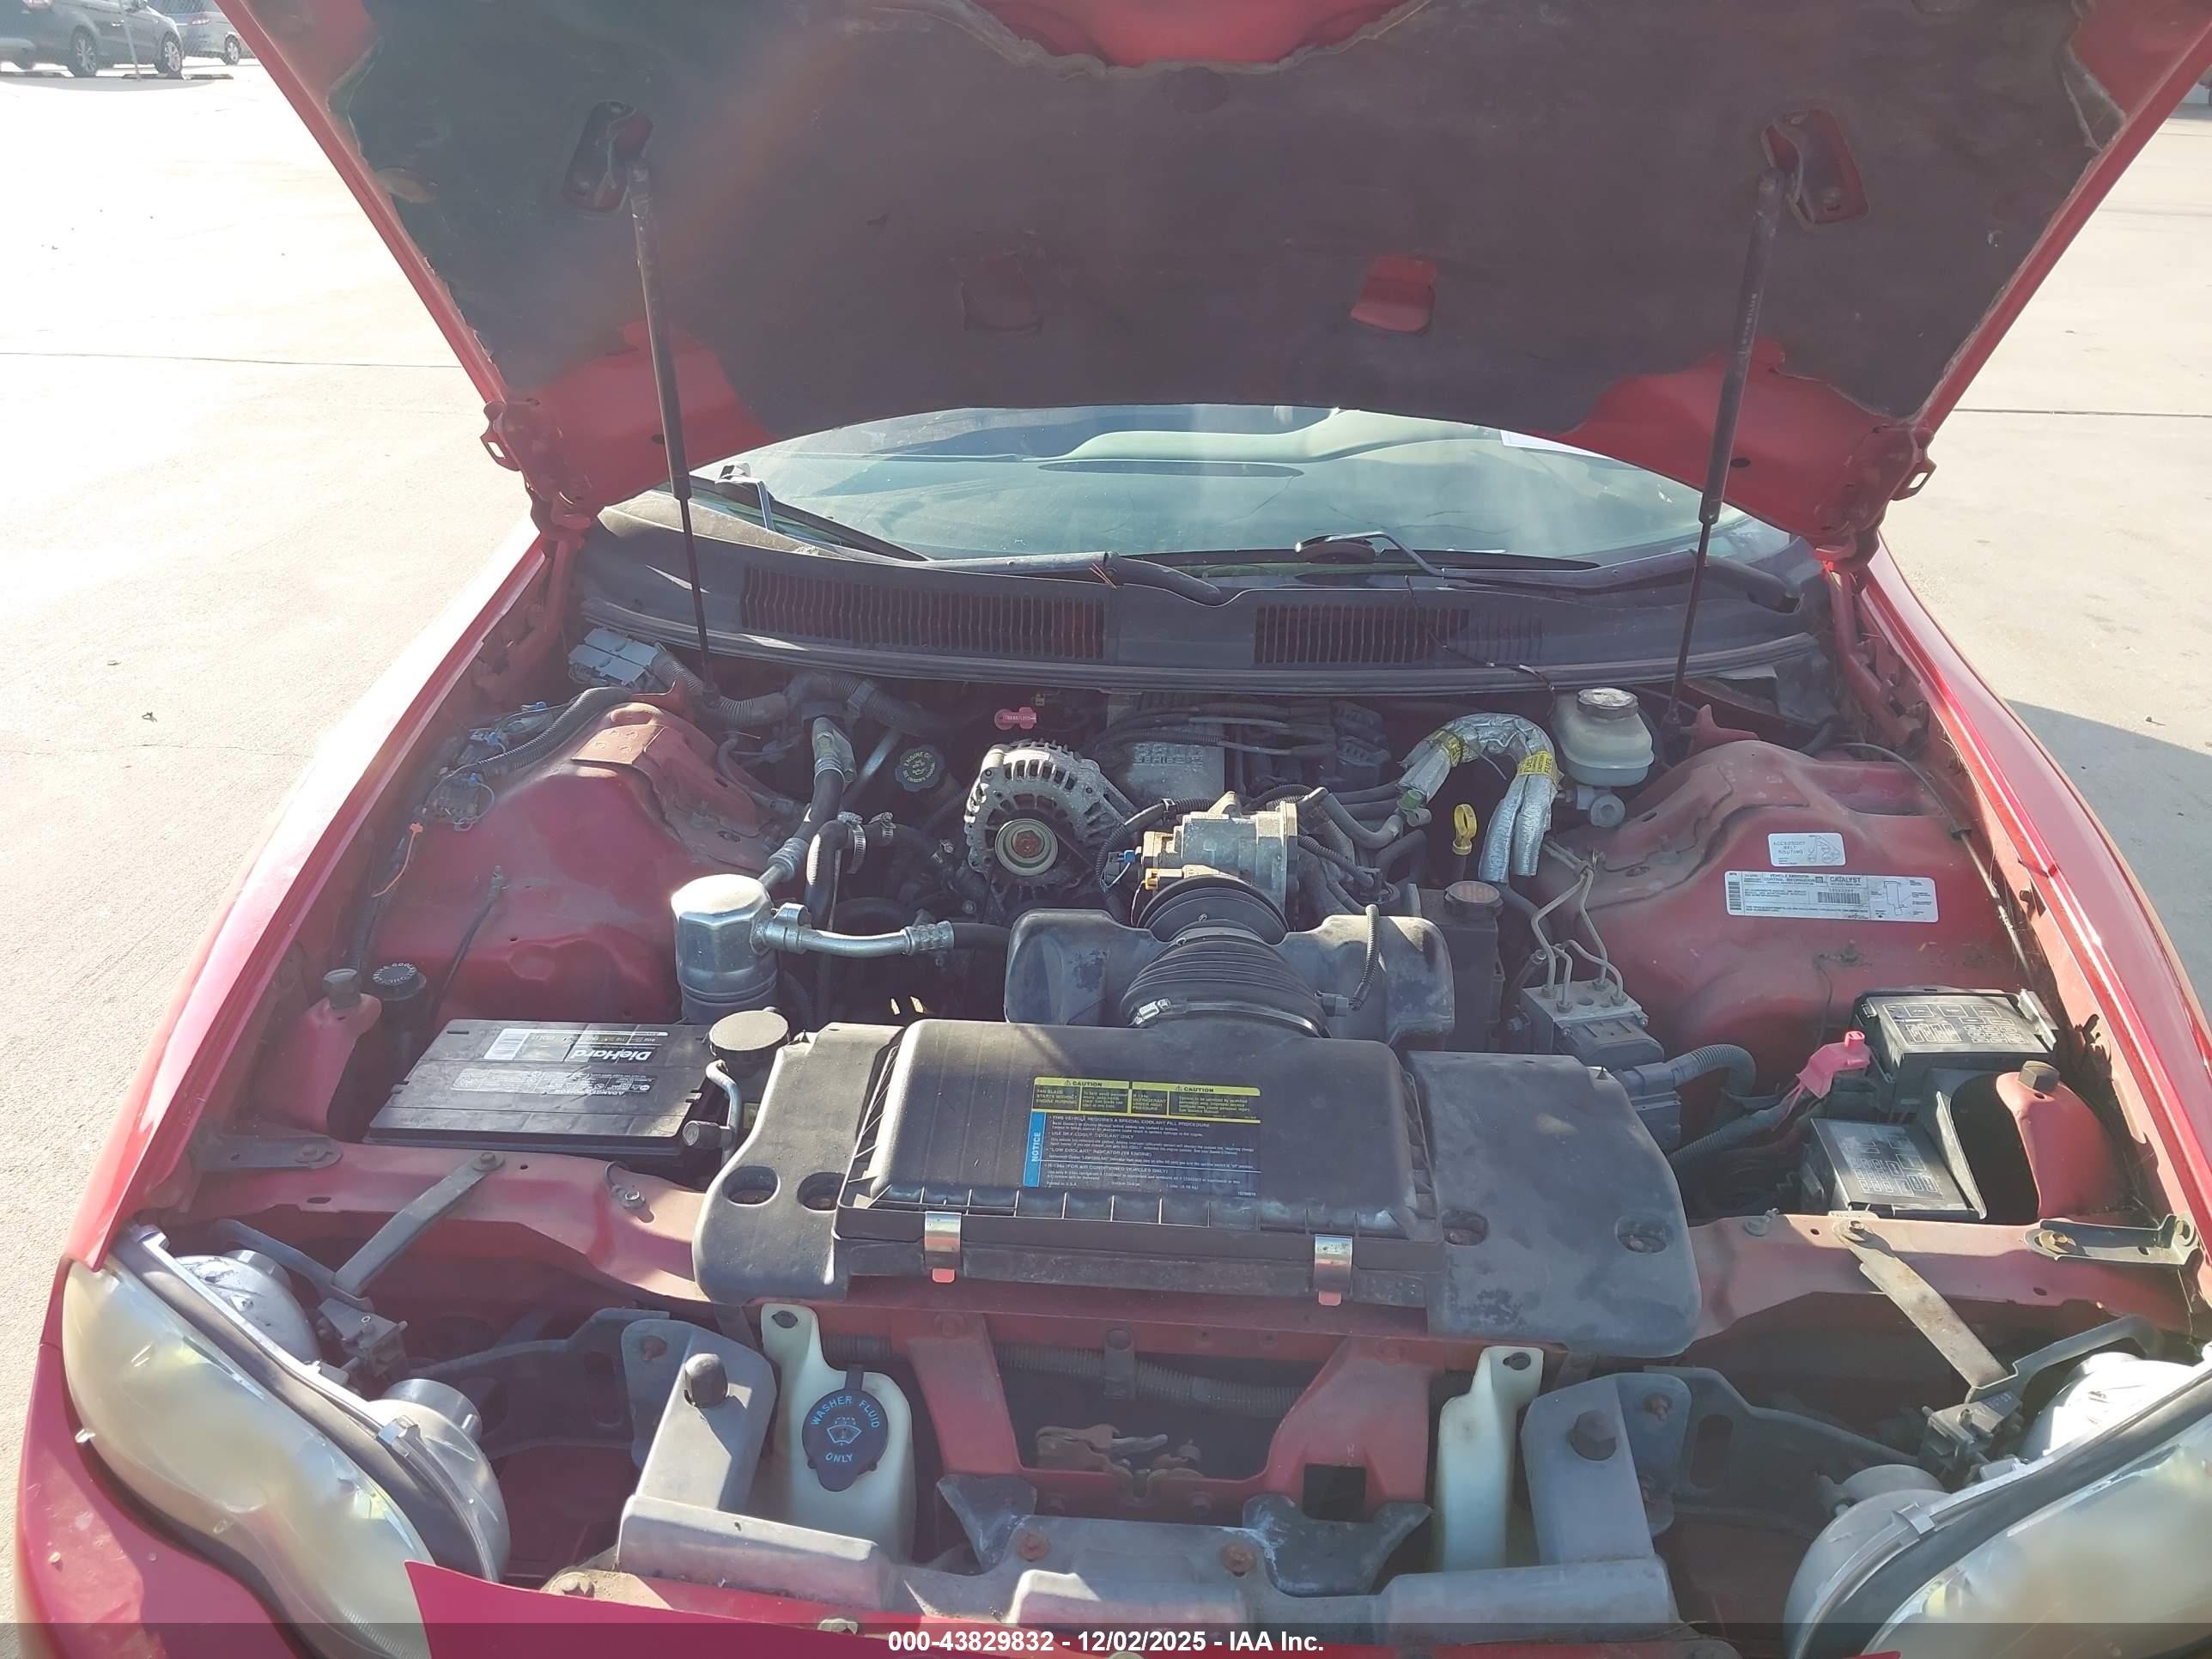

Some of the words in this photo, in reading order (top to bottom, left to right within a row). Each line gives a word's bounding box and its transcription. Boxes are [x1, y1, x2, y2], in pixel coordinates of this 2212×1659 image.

[570, 1049, 653, 1061] DieHard
[1031, 1133, 1041, 1163] NOTICE
[811, 1395, 852, 1425] WASHER
[859, 1400, 880, 1428] FLUID
[825, 1452, 853, 1463] ONLY
